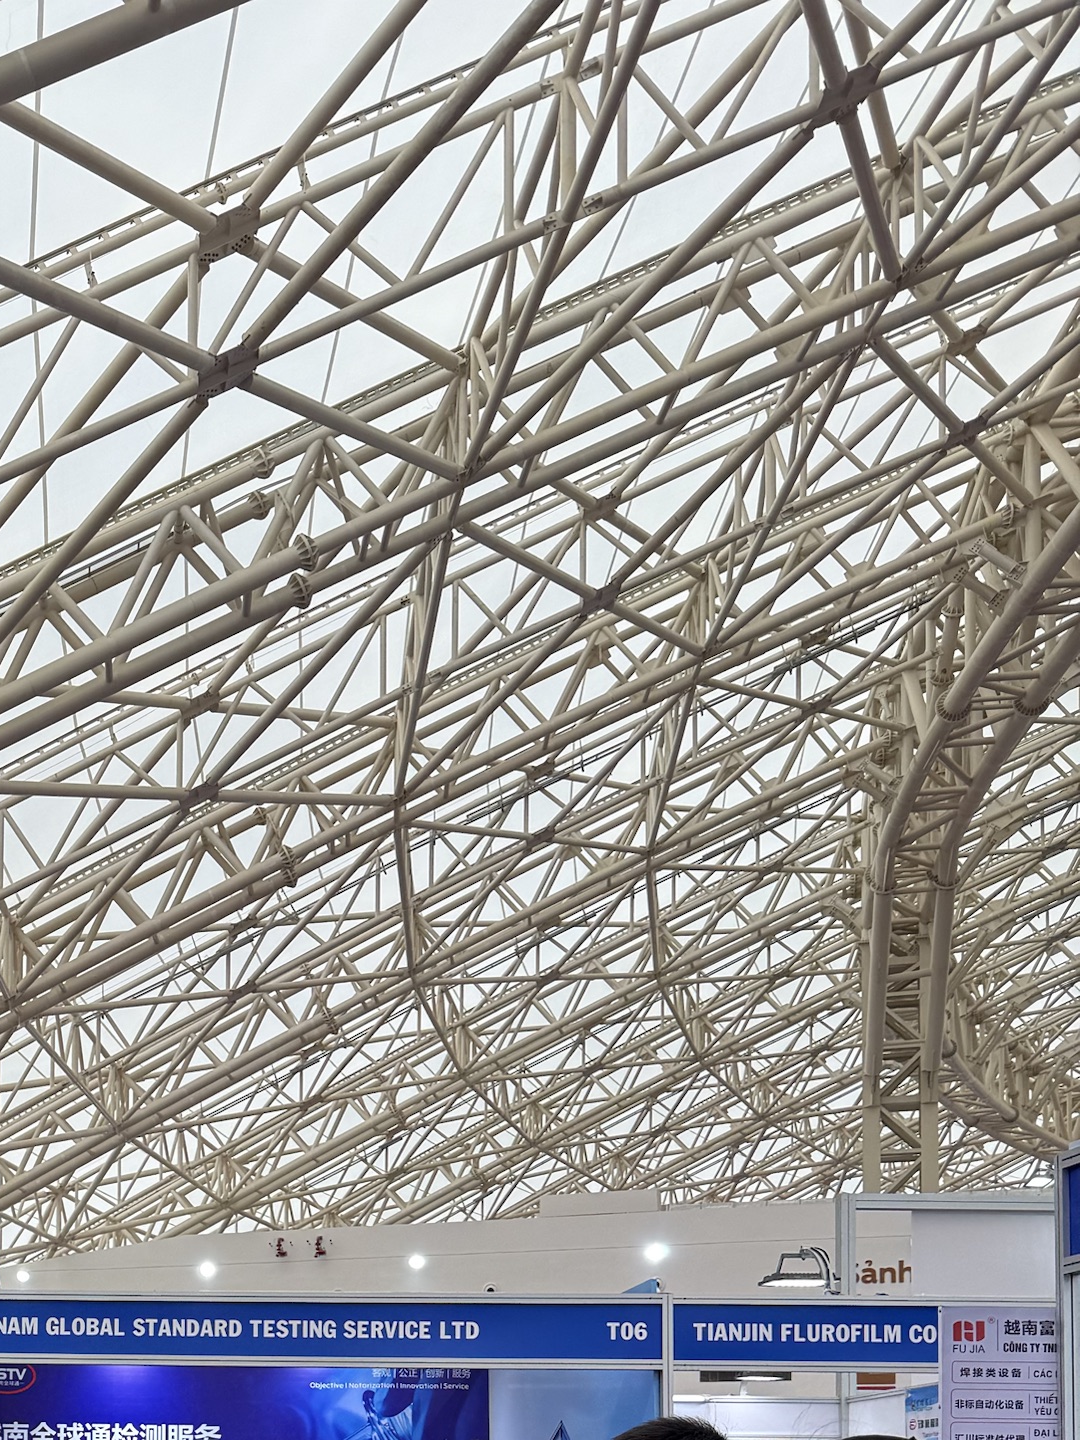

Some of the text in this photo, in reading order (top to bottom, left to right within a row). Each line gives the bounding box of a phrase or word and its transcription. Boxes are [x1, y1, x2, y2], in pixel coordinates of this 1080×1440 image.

[855, 1260, 911, 1284] ảnh
[45, 1316, 125, 1336] GLOBAL
[132, 1318, 242, 1338] STANDARD
[249, 1319, 337, 1339] TESTING
[343, 1320, 431, 1340] SERVICE
[439, 1321, 480, 1340] LTD
[606, 1321, 648, 1341] T06
[692, 1322, 938, 1344] TIANJIN FLUROFILM CO
[1004, 1319, 1055, 1336] 越南富
[952, 1344, 985, 1353] FU JIA
[1003, 1341, 1027, 1353] CÔNG
[1030, 1343, 1040, 1353] TY
[1033, 1368, 1053, 1378] CÁC
[309, 1382, 344, 1390] Objective
[399, 1382, 439, 1390] Innovation
[443, 1382, 470, 1390] Service
[955, 1399, 1024, 1410] 非标自动化设备
